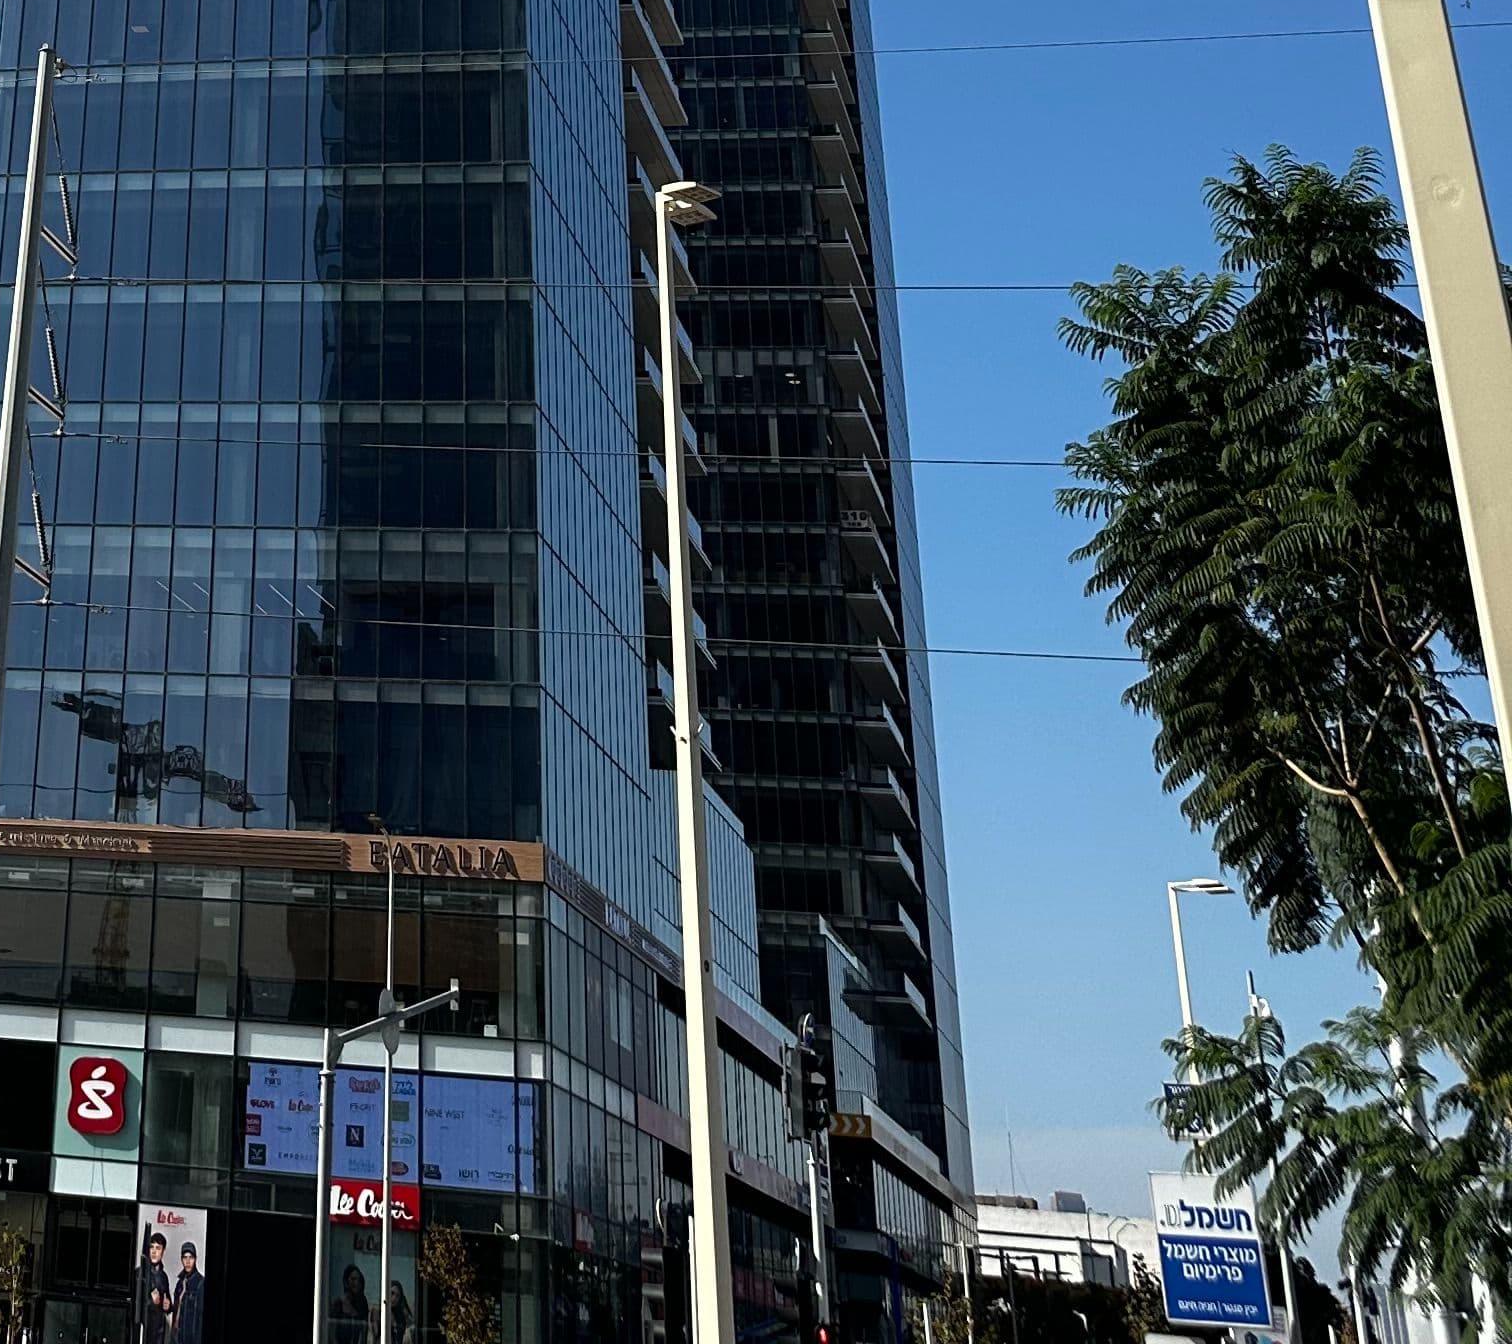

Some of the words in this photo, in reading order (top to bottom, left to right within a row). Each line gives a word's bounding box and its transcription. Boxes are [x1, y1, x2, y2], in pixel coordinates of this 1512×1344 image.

[369, 840, 512, 873] EATALIA
[330, 1185, 354, 1215] Lee
[1162, 1239, 1211, 1261] חשמל
[1214, 1245, 1257, 1265] מוצרי
